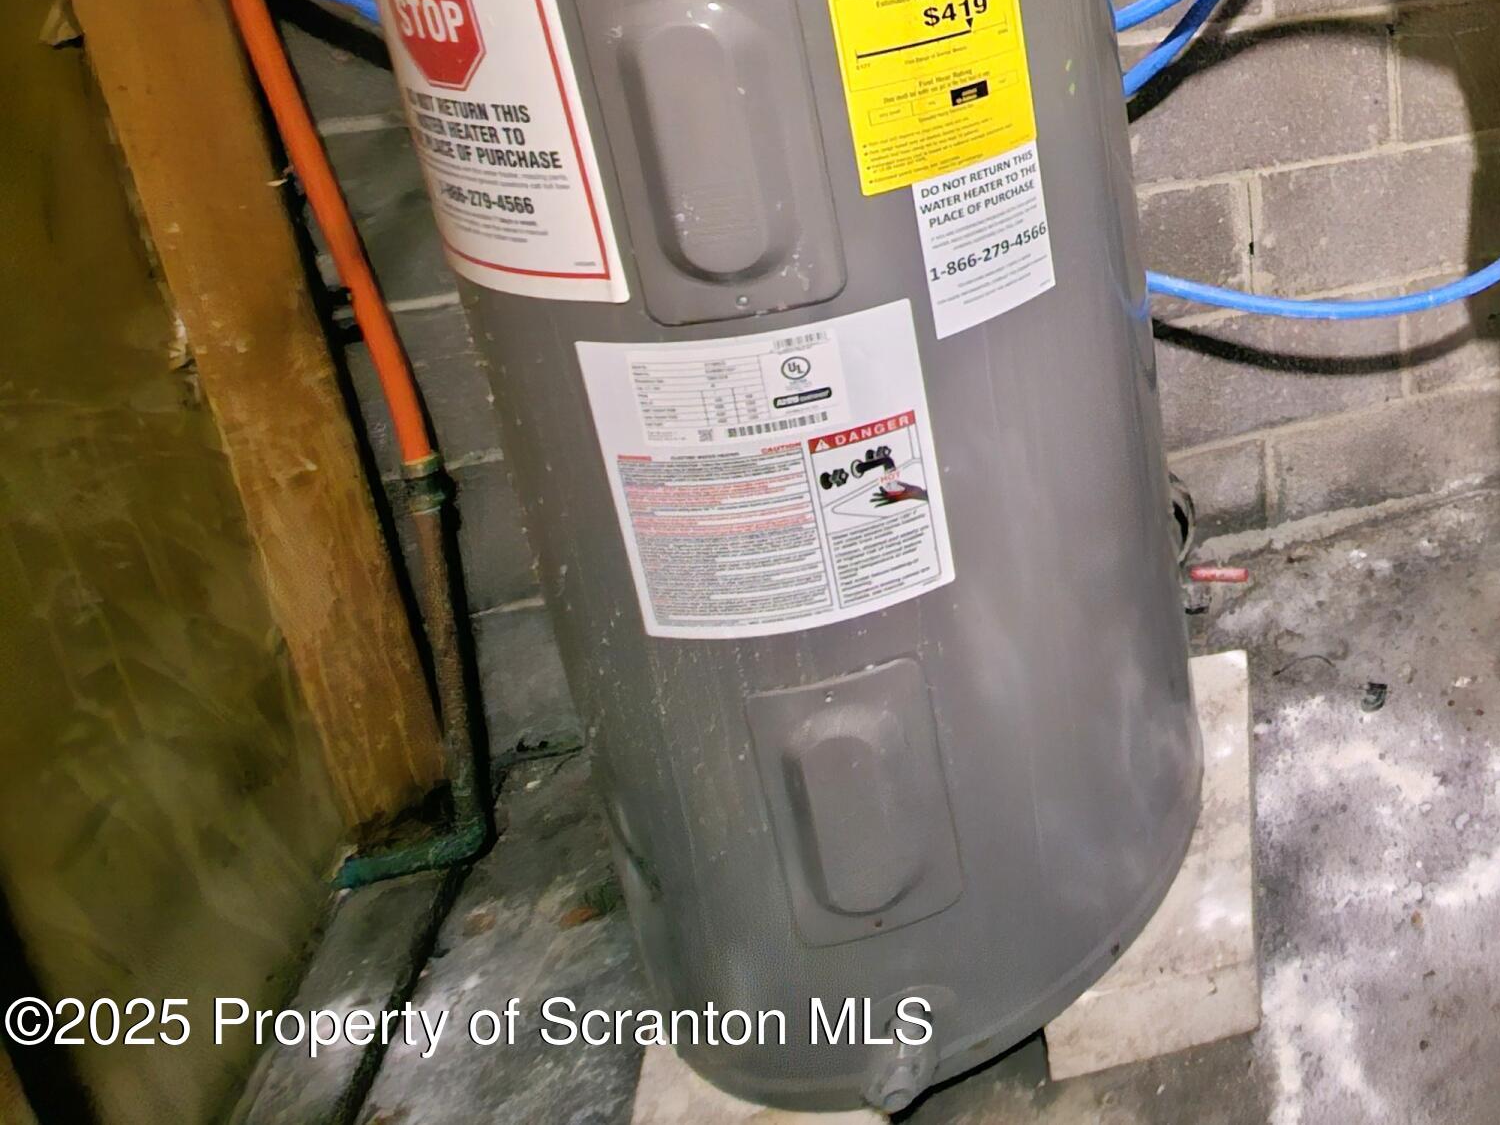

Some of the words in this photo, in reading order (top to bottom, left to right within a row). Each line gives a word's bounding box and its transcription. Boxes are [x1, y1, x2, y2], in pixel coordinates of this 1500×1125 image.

[491, 104, 531, 124] THIS
[503, 127, 526, 146] TO
[476, 146, 563, 169] PURCHASE
[920, 185, 939, 199] DO
[942, 175, 967, 192] NOT
[969, 159, 1011, 183] RETURN
[1013, 149, 1034, 166] THIS
[920, 193, 962, 215] WATER
[963, 178, 1004, 201] HEATER
[1005, 171, 1019, 184] TO
[1020, 163, 1037, 177] THE
[928, 208, 965, 228] PLACE
[967, 201, 982, 215] OF
[984, 179, 1035, 209] PURCHASE
[930, 221, 1047, 282] 1-866-279-4566
[834, 415, 910, 446] DANGER
